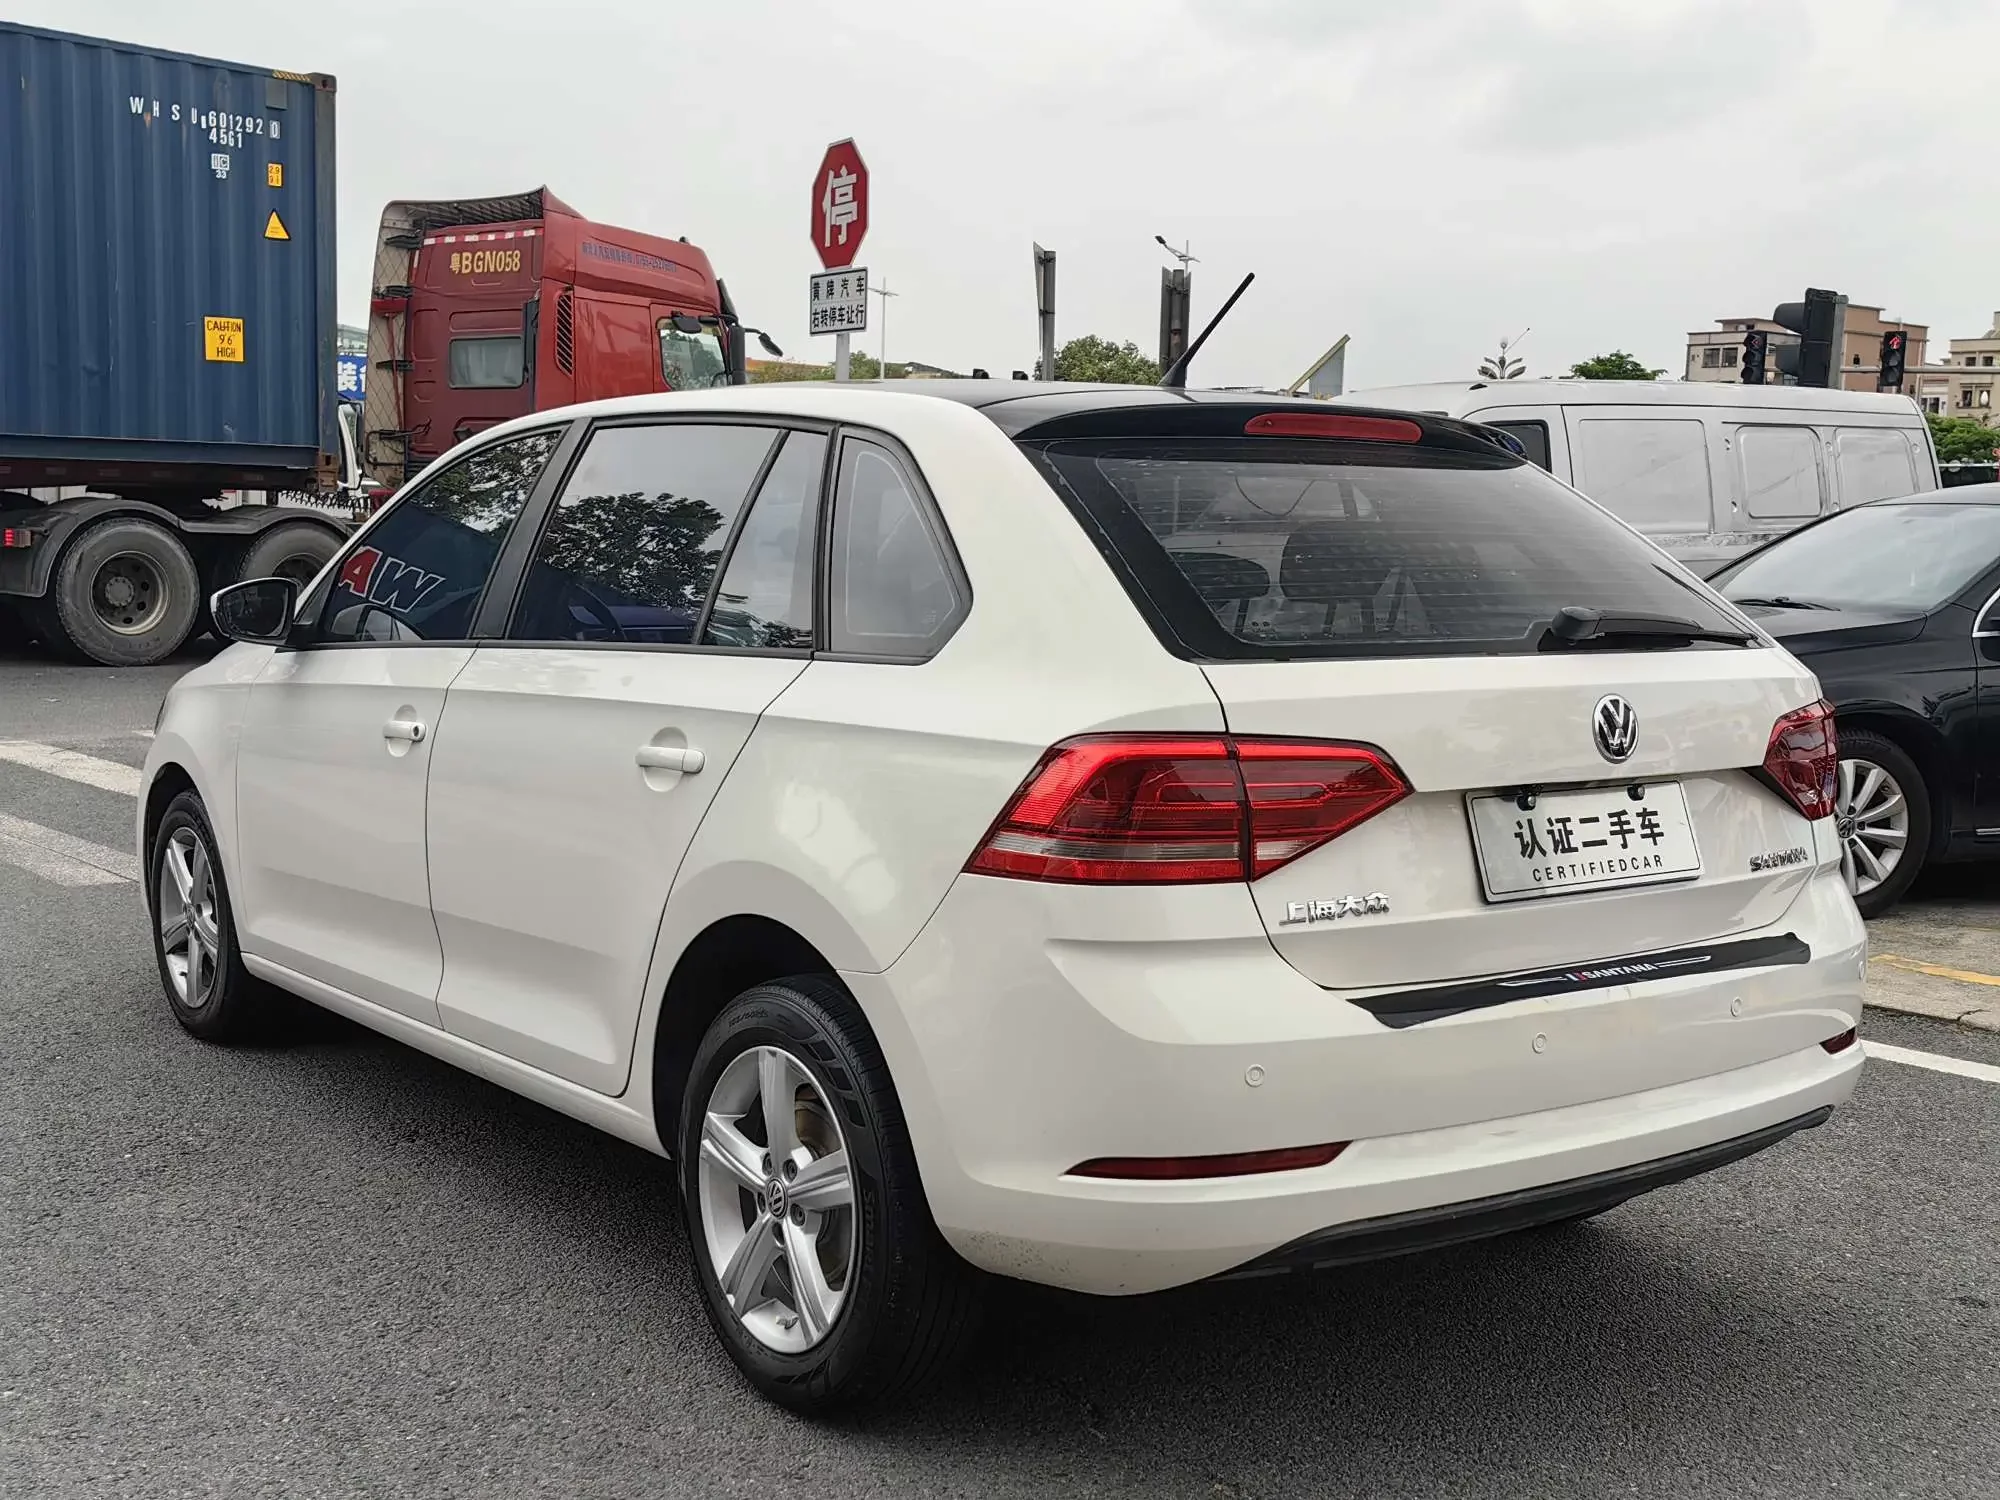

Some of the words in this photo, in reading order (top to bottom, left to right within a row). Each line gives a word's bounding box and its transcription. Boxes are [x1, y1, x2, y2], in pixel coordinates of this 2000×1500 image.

[208, 110, 264, 135] 601292
[822, 164, 860, 248] 停
[449, 250, 521, 275] 粤BGN058
[206, 319, 242, 333] CAUTION
[811, 303, 865, 329] 右转停车让行
[216, 346, 236, 358] HIGH
[1514, 807, 1665, 860] 认证二手车
[1532, 854, 1664, 883] CERTIFIEDCAR
[1278, 890, 1391, 926] 上海大众
[1586, 962, 1657, 980] SANTANA
